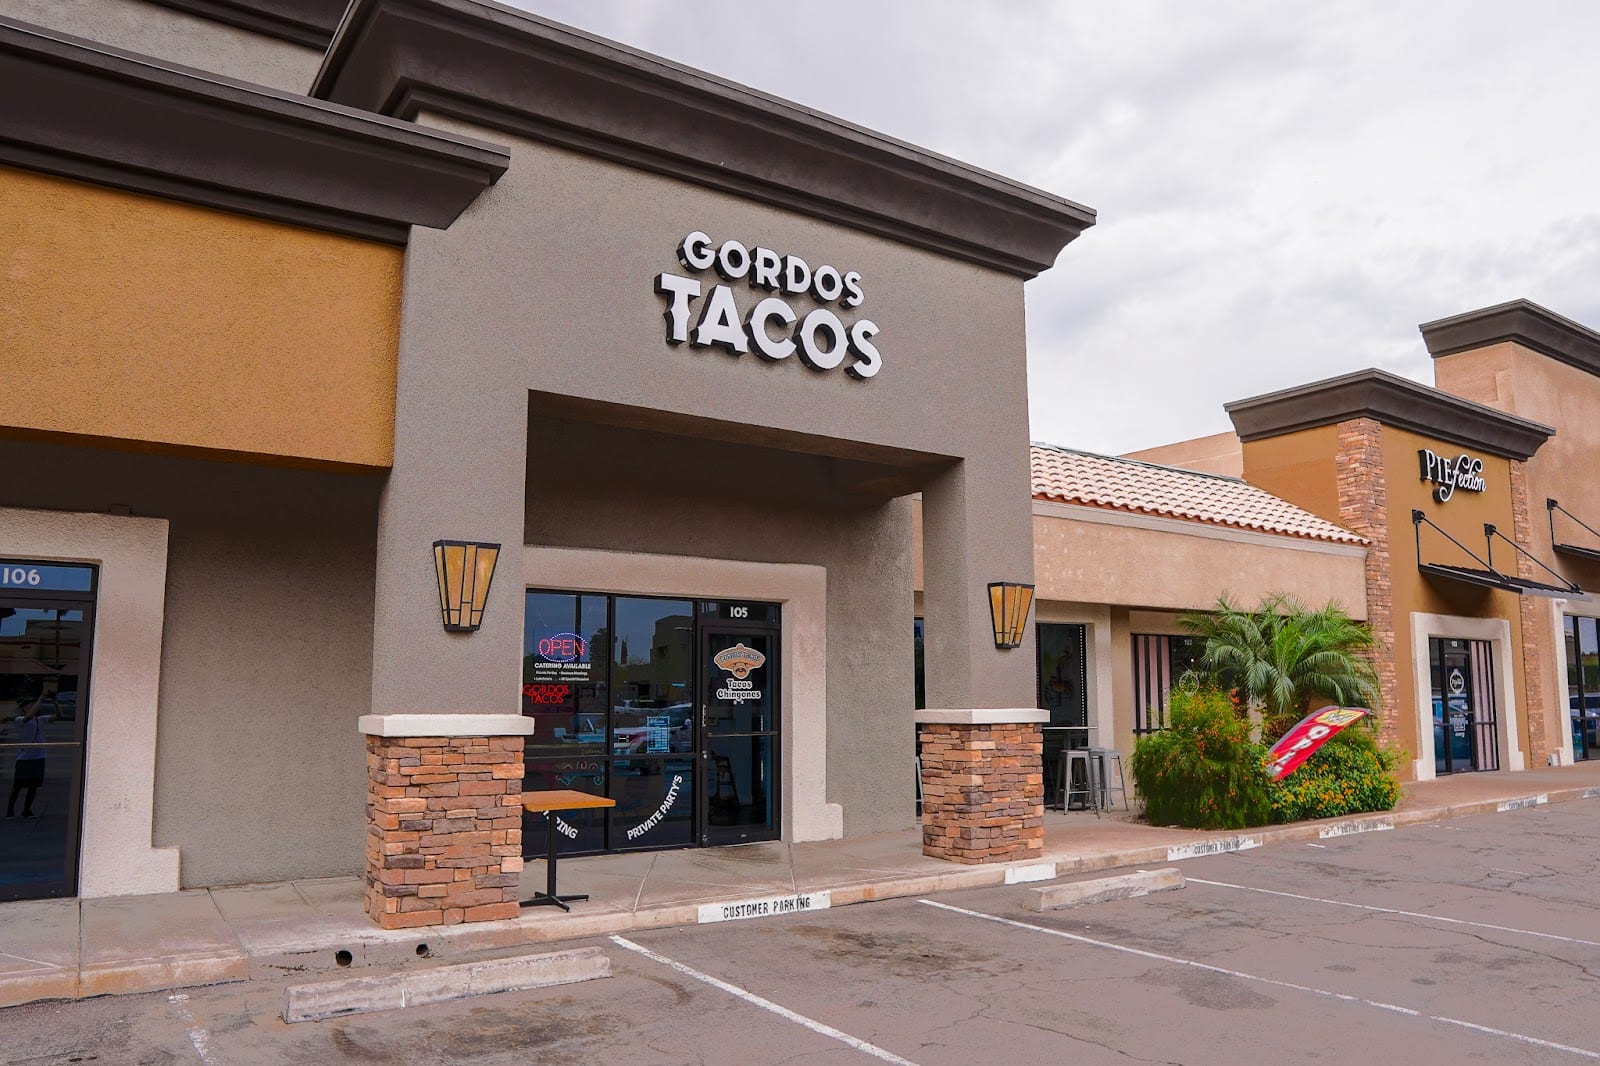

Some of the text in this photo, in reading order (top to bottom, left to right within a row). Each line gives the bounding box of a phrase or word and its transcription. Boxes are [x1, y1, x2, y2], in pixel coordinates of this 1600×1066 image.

[677, 230, 865, 309] GORDOS
[654, 272, 883, 379] TACOS
[2, 567, 41, 586] 106
[730, 606, 748, 618] 105
[538, 638, 585, 656] OPEN
[522, 684, 570, 695] GORDOS
[726, 679, 752, 688] Tacos
[530, 693, 564, 704] TACOS
[717, 689, 761, 700] Chingones
[627, 774, 683, 840] PRIVATE PARTY'S
[723, 897, 811, 919] CUSTOMER PARKING
